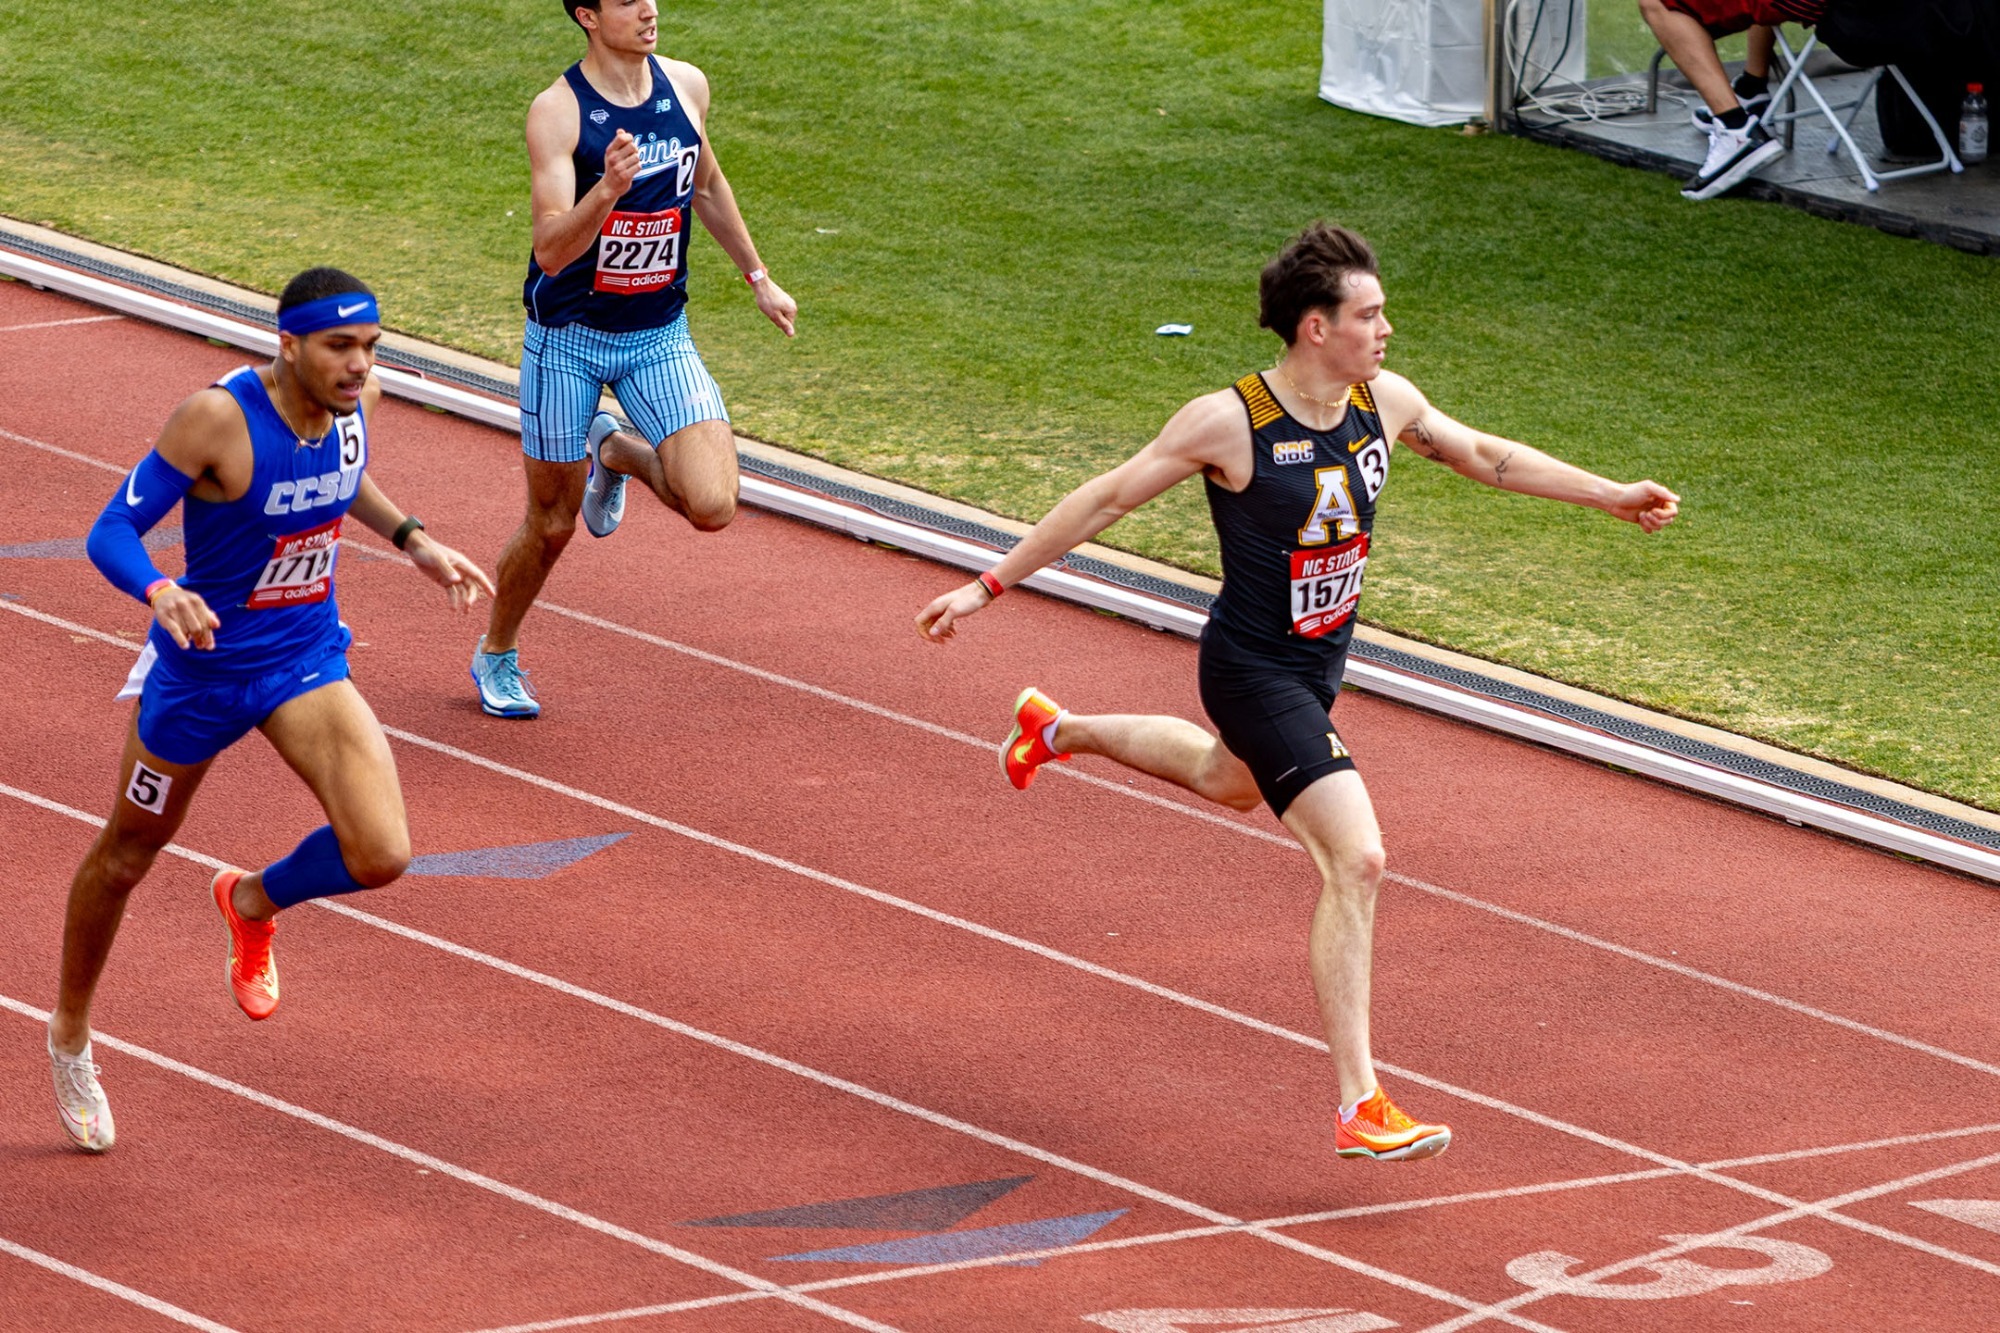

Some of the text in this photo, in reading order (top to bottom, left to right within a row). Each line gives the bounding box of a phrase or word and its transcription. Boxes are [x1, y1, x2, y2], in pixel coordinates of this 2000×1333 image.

[633, 133, 682, 164] aine
[681, 150, 696, 192] 2
[611, 217, 674, 236] NC STATE
[602, 238, 674, 270] 2274
[631, 273, 671, 286] adidas
[341, 420, 359, 466] 5
[1363, 448, 1385, 493] 3
[264, 468, 362, 515] CCSU
[1298, 465, 1360, 546] A
[1302, 543, 1361, 577] NC STATE
[1297, 565, 1360, 613] 1571
[131, 767, 162, 806] 5
